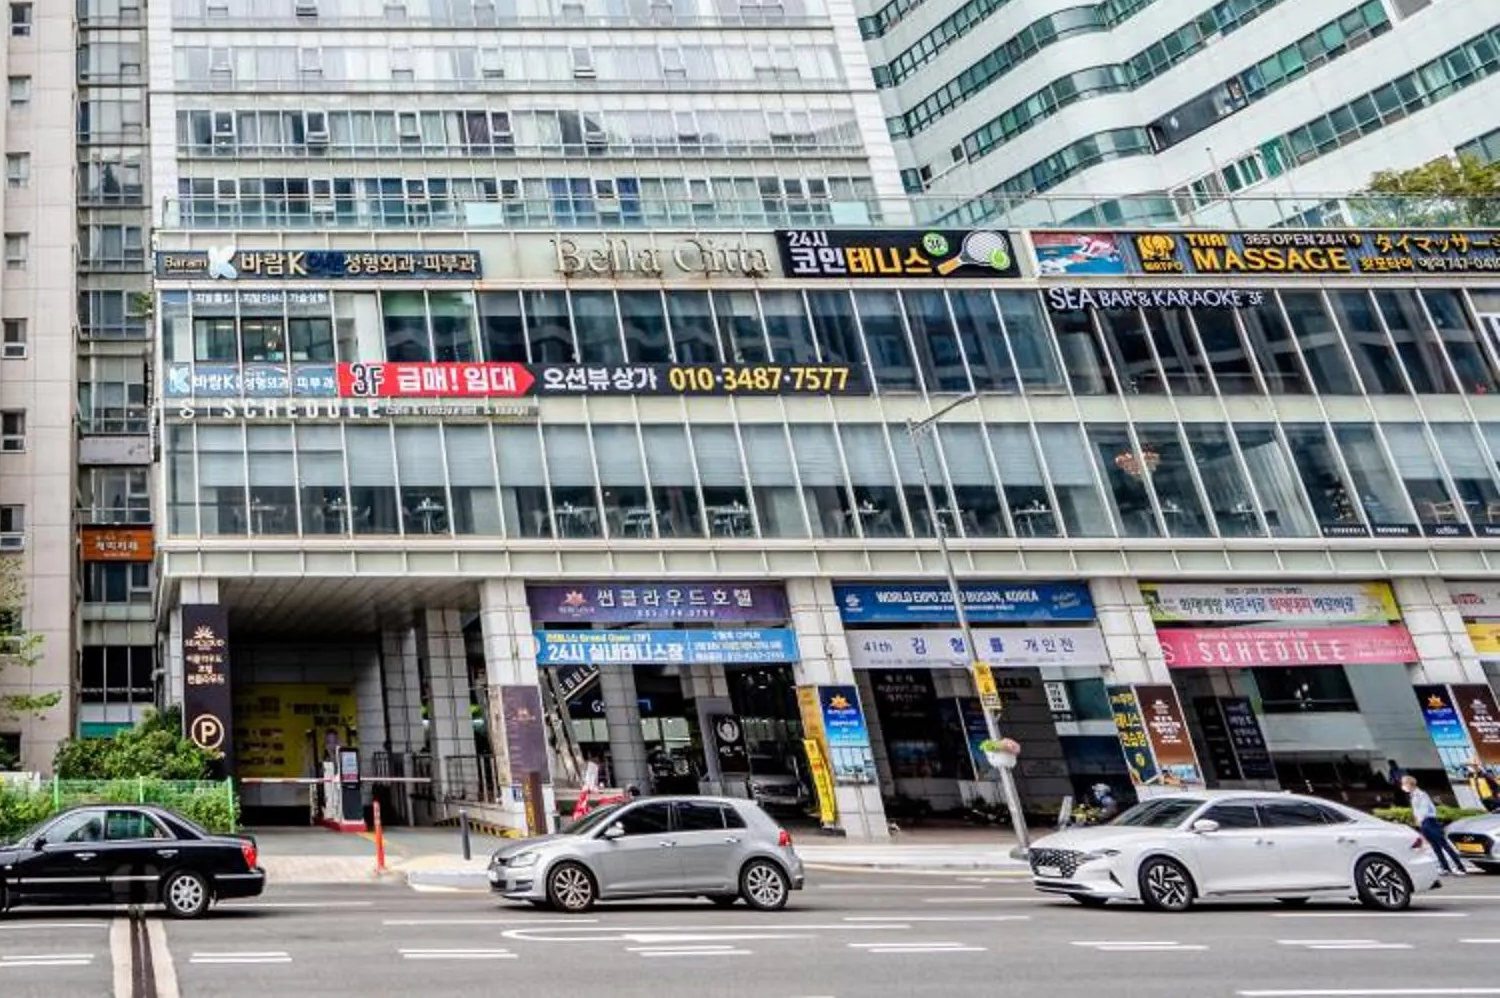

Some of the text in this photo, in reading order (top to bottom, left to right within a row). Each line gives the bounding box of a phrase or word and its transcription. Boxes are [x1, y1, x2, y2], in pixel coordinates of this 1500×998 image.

[787, 231, 829, 247] 24시
[1185, 233, 1228, 247] THAI
[1244, 233, 1271, 246] 365
[1272, 233, 1316, 246] OPEN
[163, 255, 207, 268] Baram
[550, 238, 663, 274] Bella
[790, 247, 932, 274] 코인테니스
[1191, 248, 1351, 271] MASSAGE
[1049, 287, 1099, 309] SEA
[1152, 289, 1243, 306] KARAOKE
[1248, 292, 1264, 306] 3F
[351, 362, 517, 397] 3F 급매! 임대
[222, 399, 381, 418] SCHEDULE
[875, 591, 913, 603] WORLD
[914, 591, 939, 603] EXPO
[940, 591, 965, 603] 200
[1005, 589, 1039, 602] KOREA
[547, 643, 586, 662] 24시
[1201, 639, 1347, 665] SCHEDULE
